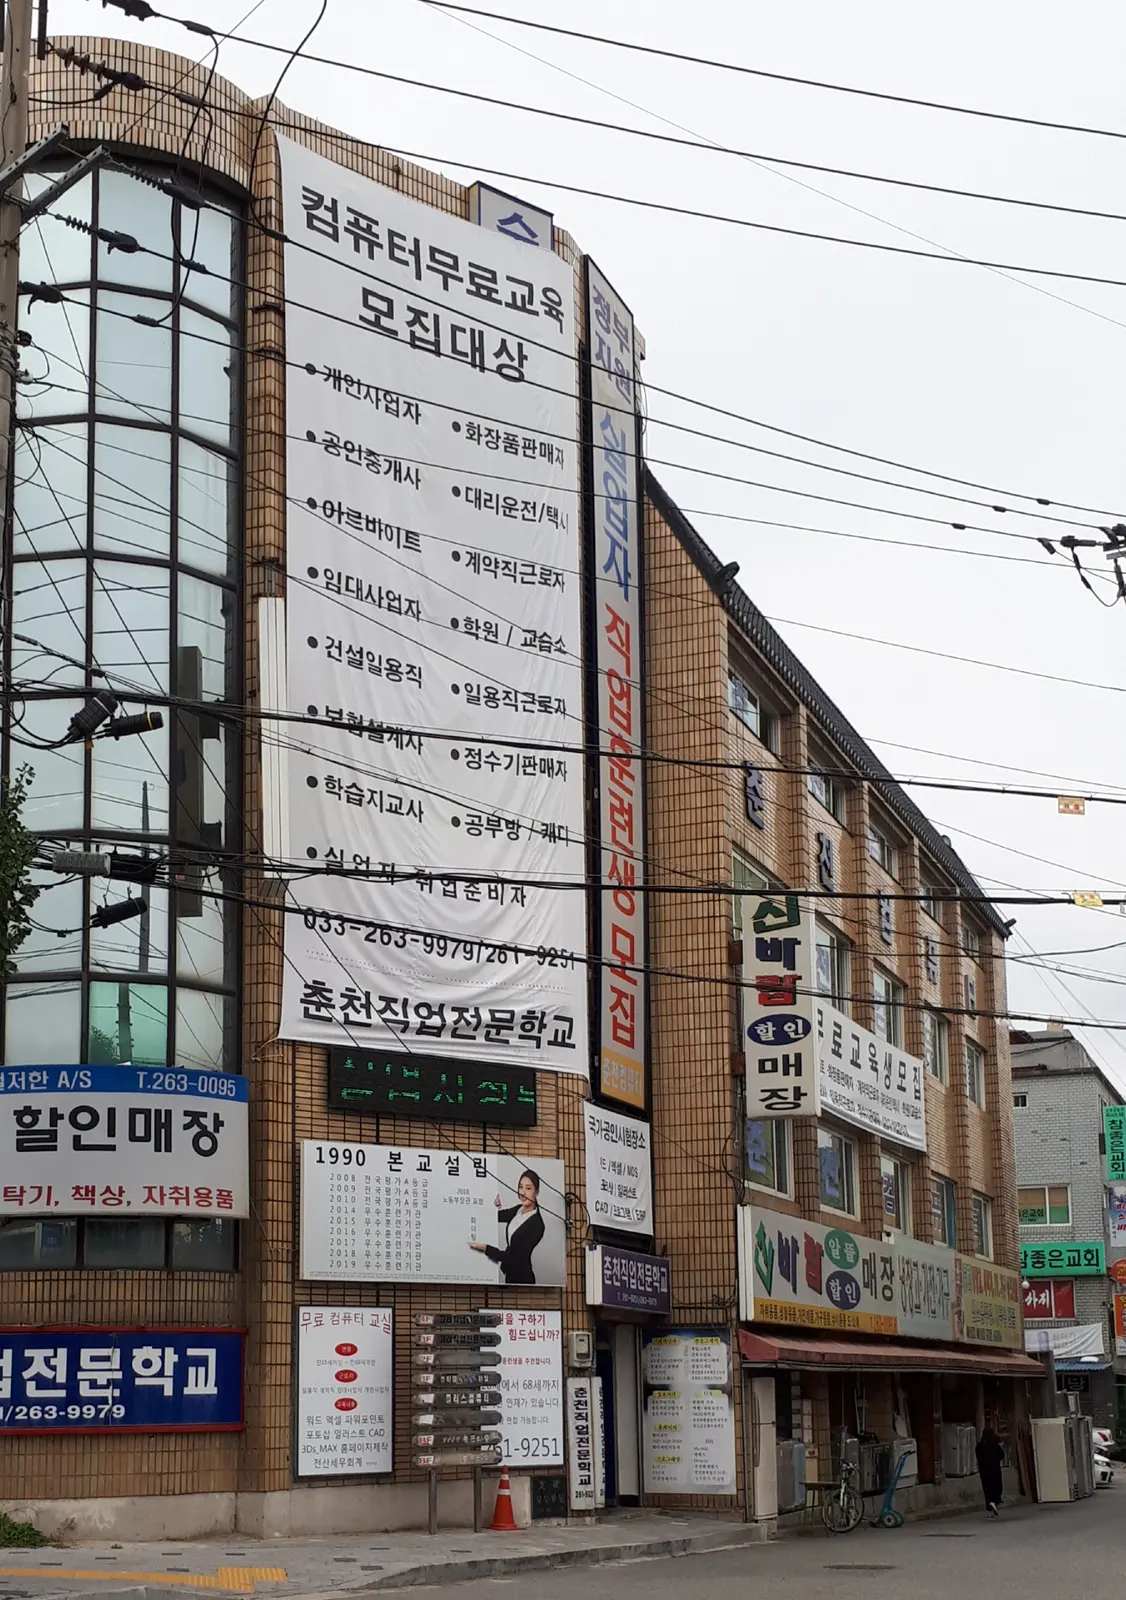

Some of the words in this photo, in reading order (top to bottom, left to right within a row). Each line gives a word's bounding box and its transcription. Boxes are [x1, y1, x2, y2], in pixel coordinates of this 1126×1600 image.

[301, 185, 563, 334] 컴퓨터무료교육
[359, 286, 528, 382] 모집대상
[323, 365, 421, 425] 개인사업자
[465, 421, 564, 469] 화장품판매자
[322, 430, 421, 490] 공인중개사
[600, 411, 631, 604] 실업자
[322, 499, 422, 553] 아르바이트
[465, 550, 565, 593] 계약직근로자
[323, 567, 421, 622] 임대사업자
[463, 616, 499, 645] 학원
[324, 635, 423, 689] 건설일용직
[464, 682, 567, 720] 일용직근로자
[463, 747, 567, 782] 정수기판매자
[324, 774, 424, 823] 학습지교사
[464, 813, 521, 841] 공부방
[299, 979, 577, 1049] 춘천직업전문학교
[754, 1018, 805, 1042] 할인
[57, 1070, 92, 1090] A/S
[137, 1071, 236, 1097] T.263-0095
[758, 1052, 807, 1111] 매장
[13, 1105, 225, 1157] 할인매장
[588, 1115, 646, 1149] 국가공인시험장소
[316, 1146, 366, 1166] 1990
[329, 1173, 356, 1182] 2008
[329, 1184, 356, 1193] 2009
[71, 1184, 131, 1207] 책상,
[143, 1185, 233, 1210] 자취용품
[329, 1194, 356, 1204] 2010
[329, 1206, 356, 1214] 2014
[329, 1217, 356, 1225] 2015
[329, 1227, 356, 1236] 2016
[329, 1238, 356, 1246] 2017
[329, 1249, 356, 1257] 2018
[329, 1260, 356, 1268] 2019
[603, 1255, 668, 1293] 춘천직업전문학교
[862, 1252, 895, 1302] 매장
[301, 1311, 324, 1333] 무료
[330, 1311, 364, 1326] 컴퓨터
[369, 1313, 391, 1334] 교실
[518, 1313, 546, 1326] 구하기
[508, 1329, 560, 1342] 힘드십니까?
[522, 1379, 559, 1392] 68세까지
[306, 1415, 322, 1425] 워드
[326, 1415, 342, 1425] 엑셀
[345, 1414, 385, 1425] 파워포인트
[306, 1430, 330, 1440] 포토샵
[334, 1429, 366, 1439] 일러스트
[368, 1428, 385, 1437] CAD
[573, 1387, 591, 1486] 춘천직업전문학교
[341, 1442, 388, 1454] 홈페이지제작
[486, 1438, 560, 1458] 1-9251
[313, 1457, 363, 1469] 전산세무회계
